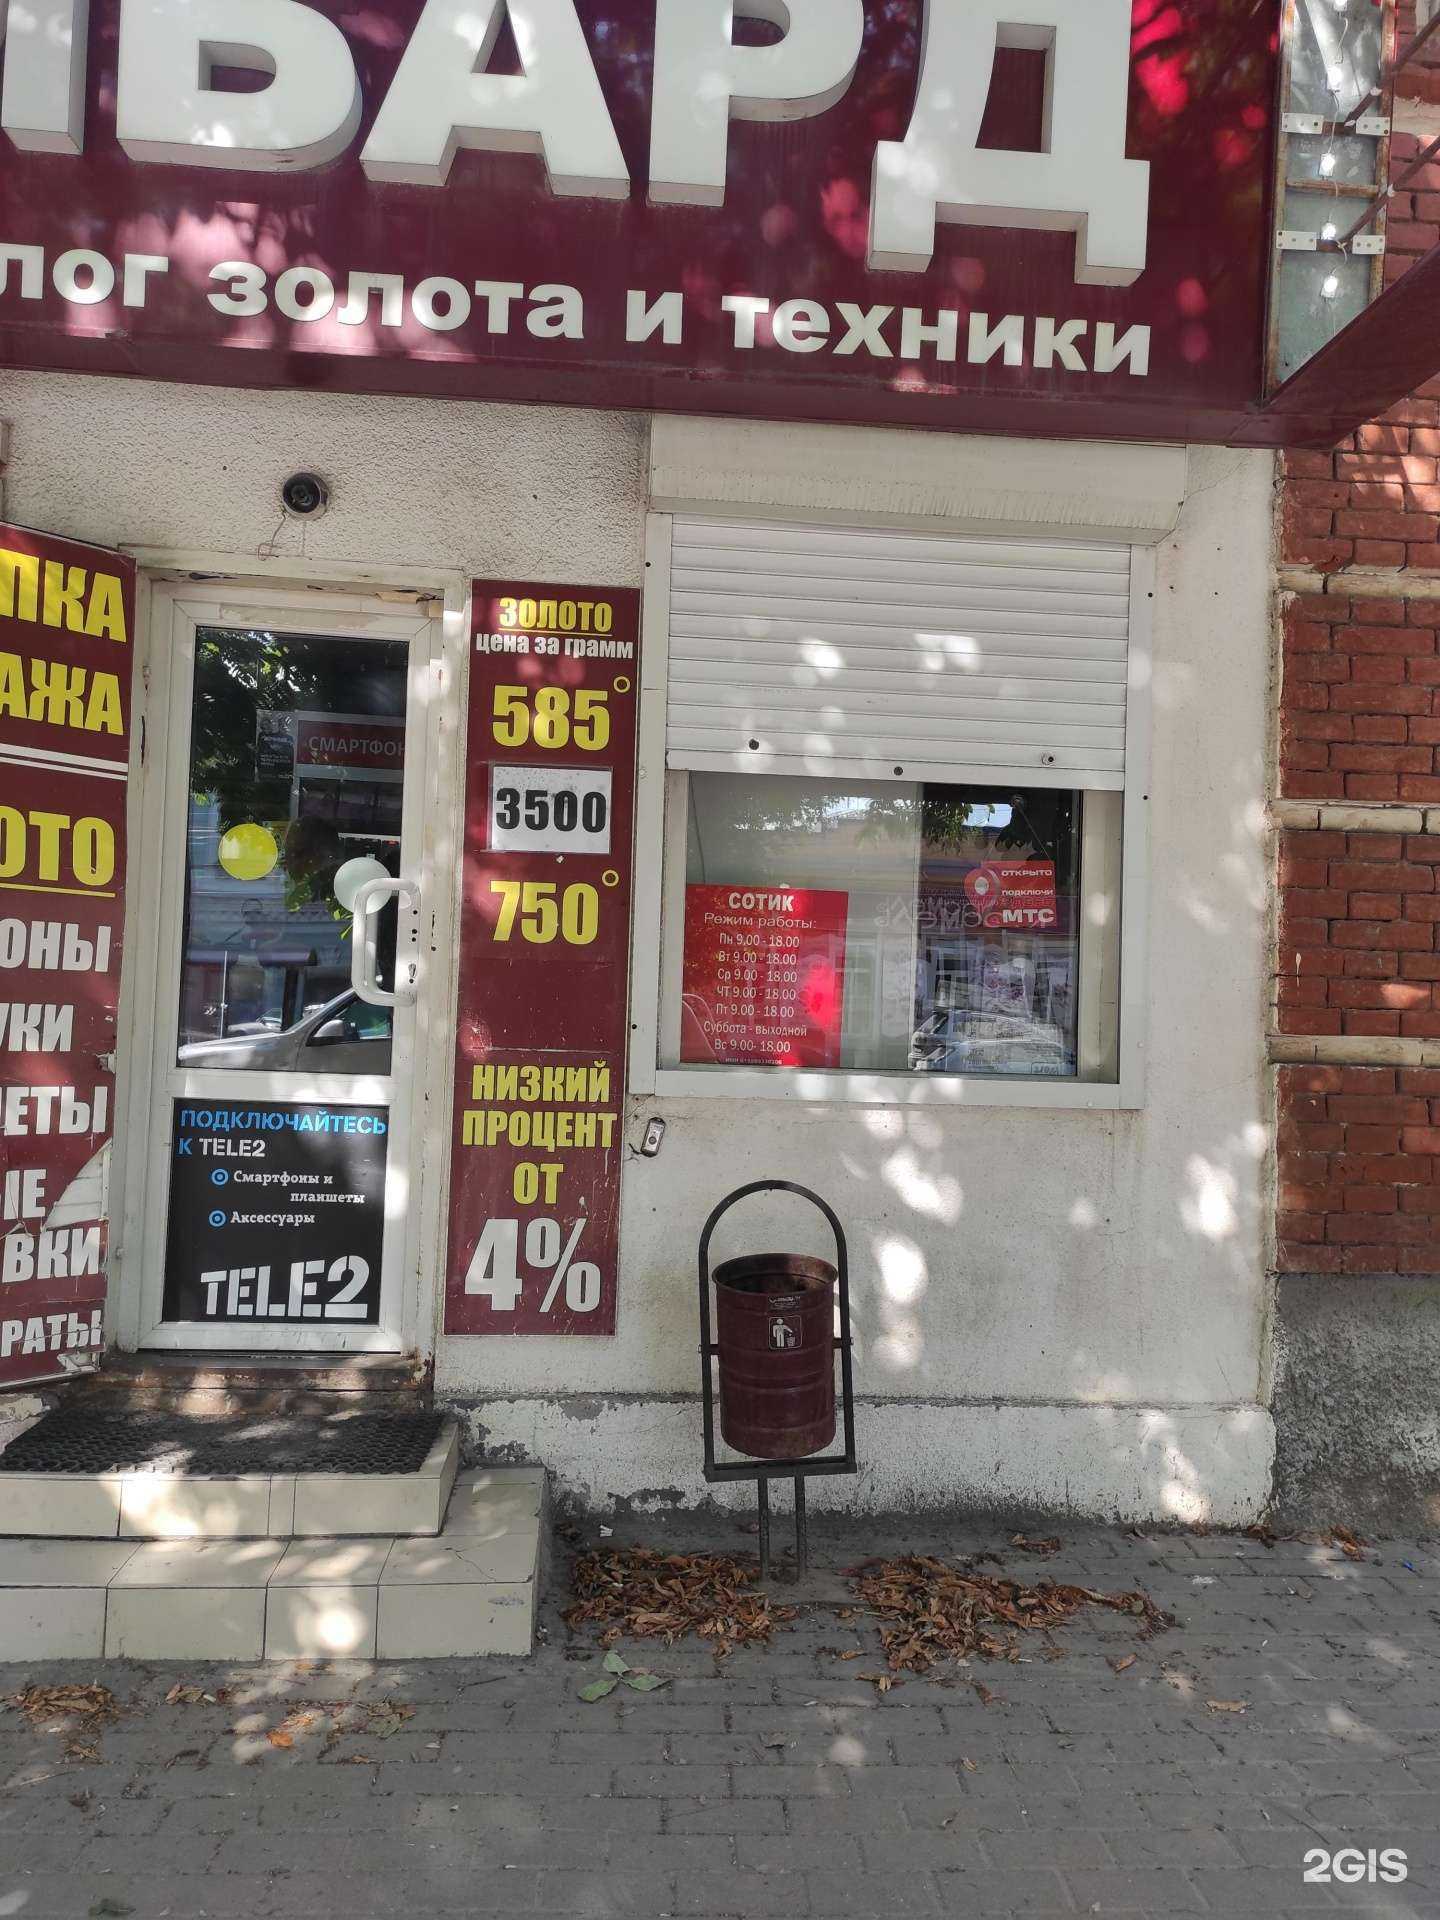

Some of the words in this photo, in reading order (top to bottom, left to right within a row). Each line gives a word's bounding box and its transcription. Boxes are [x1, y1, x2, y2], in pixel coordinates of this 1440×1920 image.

[0, 0, 1151, 287] БАРД
[206, 259, 585, 339] золота
[625, 289, 684, 345] и
[721, 294, 1152, 376] техники
[498, 597, 613, 633] ЗОЛОТО
[476, 632, 531, 655] цена
[534, 636, 560, 656] за
[564, 637, 634, 660] грамм
[495, 787, 607, 834] 3500
[1001, 868, 1053, 877] ОТКРЫТО
[728, 892, 794, 911] СОТИК
[704, 913, 753, 926] Режим
[758, 915, 817, 929] работы:
[1002, 908, 1055, 923] МТС
[0, 917, 111, 973] ОНЫ
[769, 935, 800, 948] 18.00
[766, 952, 797, 965] 18.00
[767, 970, 798, 983] 18.00
[765, 988, 796, 1000] 18.00
[763, 1005, 794, 1018] 18.00
[0, 1002, 74, 1052] КИ
[703, 1021, 747, 1035] Суббота
[755, 1022, 808, 1036] выходной
[760, 1041, 791, 1053] 18.00
[472, 1060, 610, 1103] НИЗКИЙ
[0, 1085, 108, 1137] ЕТЫ
[180, 1110, 387, 1135] ПОДКЛЮЧАЙТЕСЬ
[462, 1110, 617, 1152] ПРОЦЕНТ
[177, 1137, 193, 1155] К
[199, 1138, 267, 1157] TELE2
[233, 1170, 319, 1187] Смартфоны
[323, 1174, 334, 1184] и
[513, 1162, 564, 1205] ОТ
[290, 1192, 365, 1204] планшеты
[230, 1211, 315, 1227] Аксессуары
[2, 1227, 100, 1283] ВКИ
[464, 1216, 601, 1313] 4%
[200, 1255, 370, 1319] TELE2
[1, 1309, 102, 1357] РАТЫ
